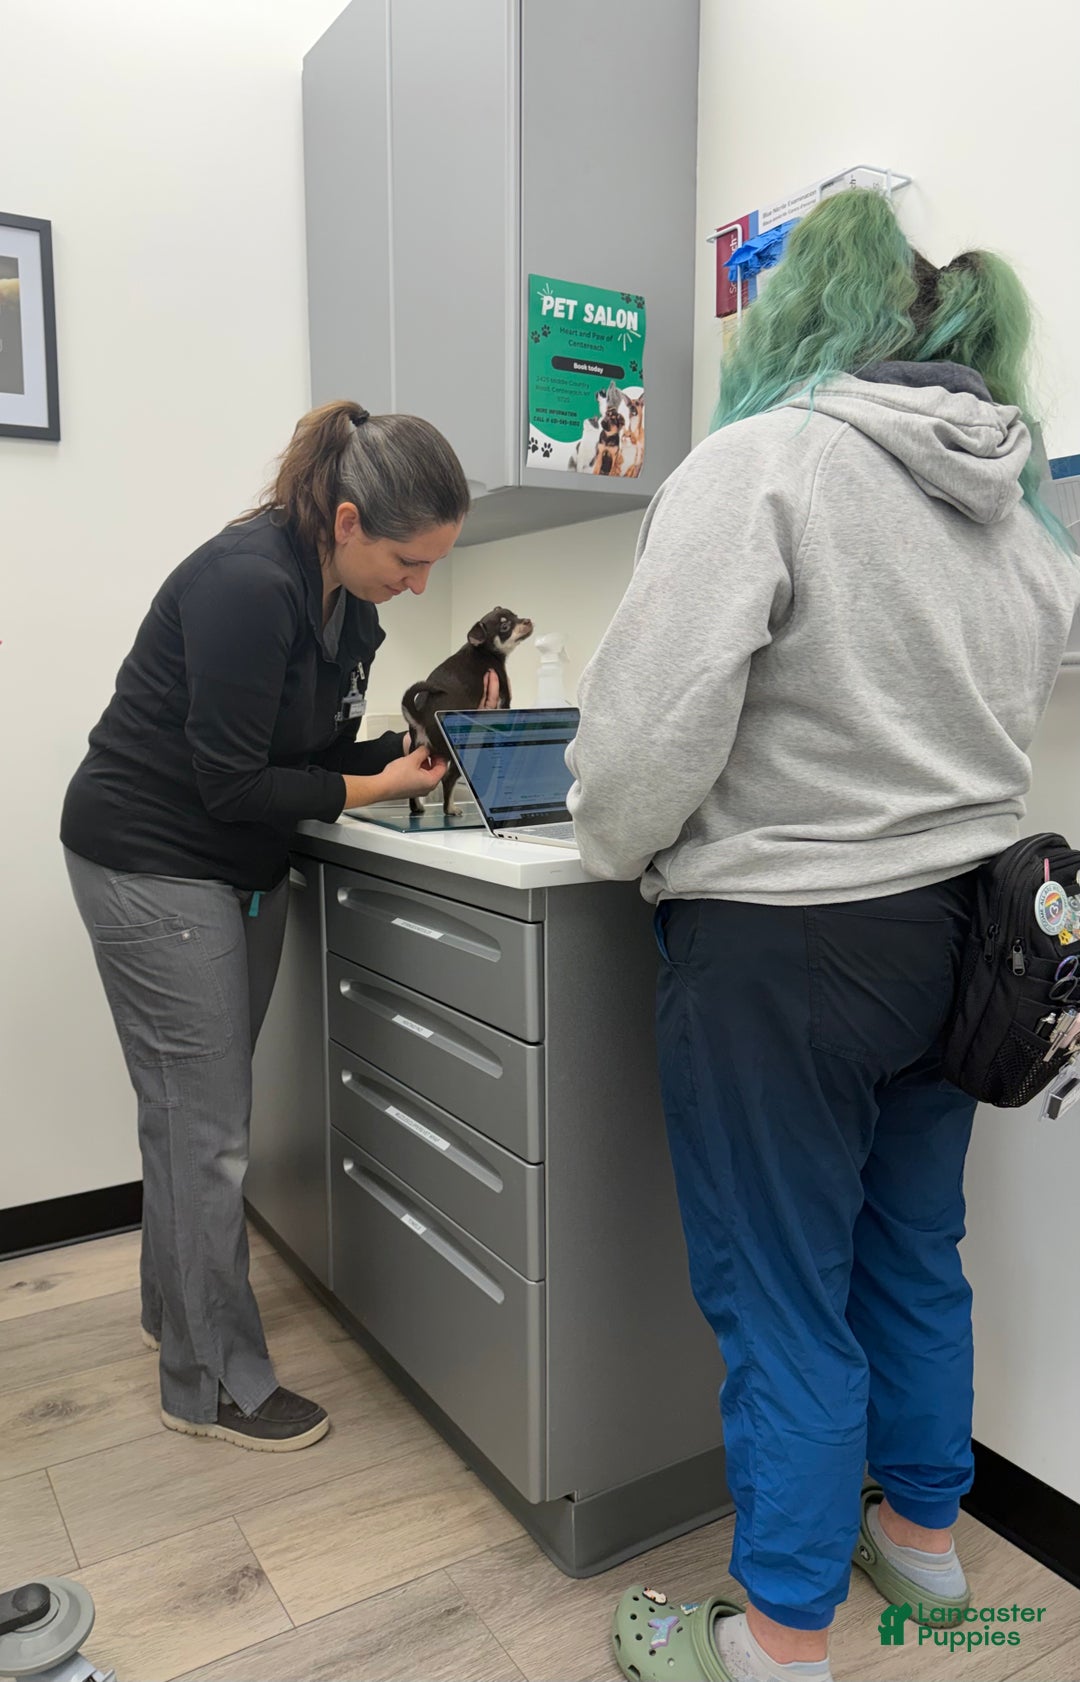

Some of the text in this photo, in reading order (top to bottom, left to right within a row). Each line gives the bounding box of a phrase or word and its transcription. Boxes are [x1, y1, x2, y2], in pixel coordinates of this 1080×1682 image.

[541, 295, 639, 331] PET SALON
[559, 327, 614, 342] Heart and Paw of
[568, 339, 605, 352] Centereach
[573, 362, 604, 374] Book today
